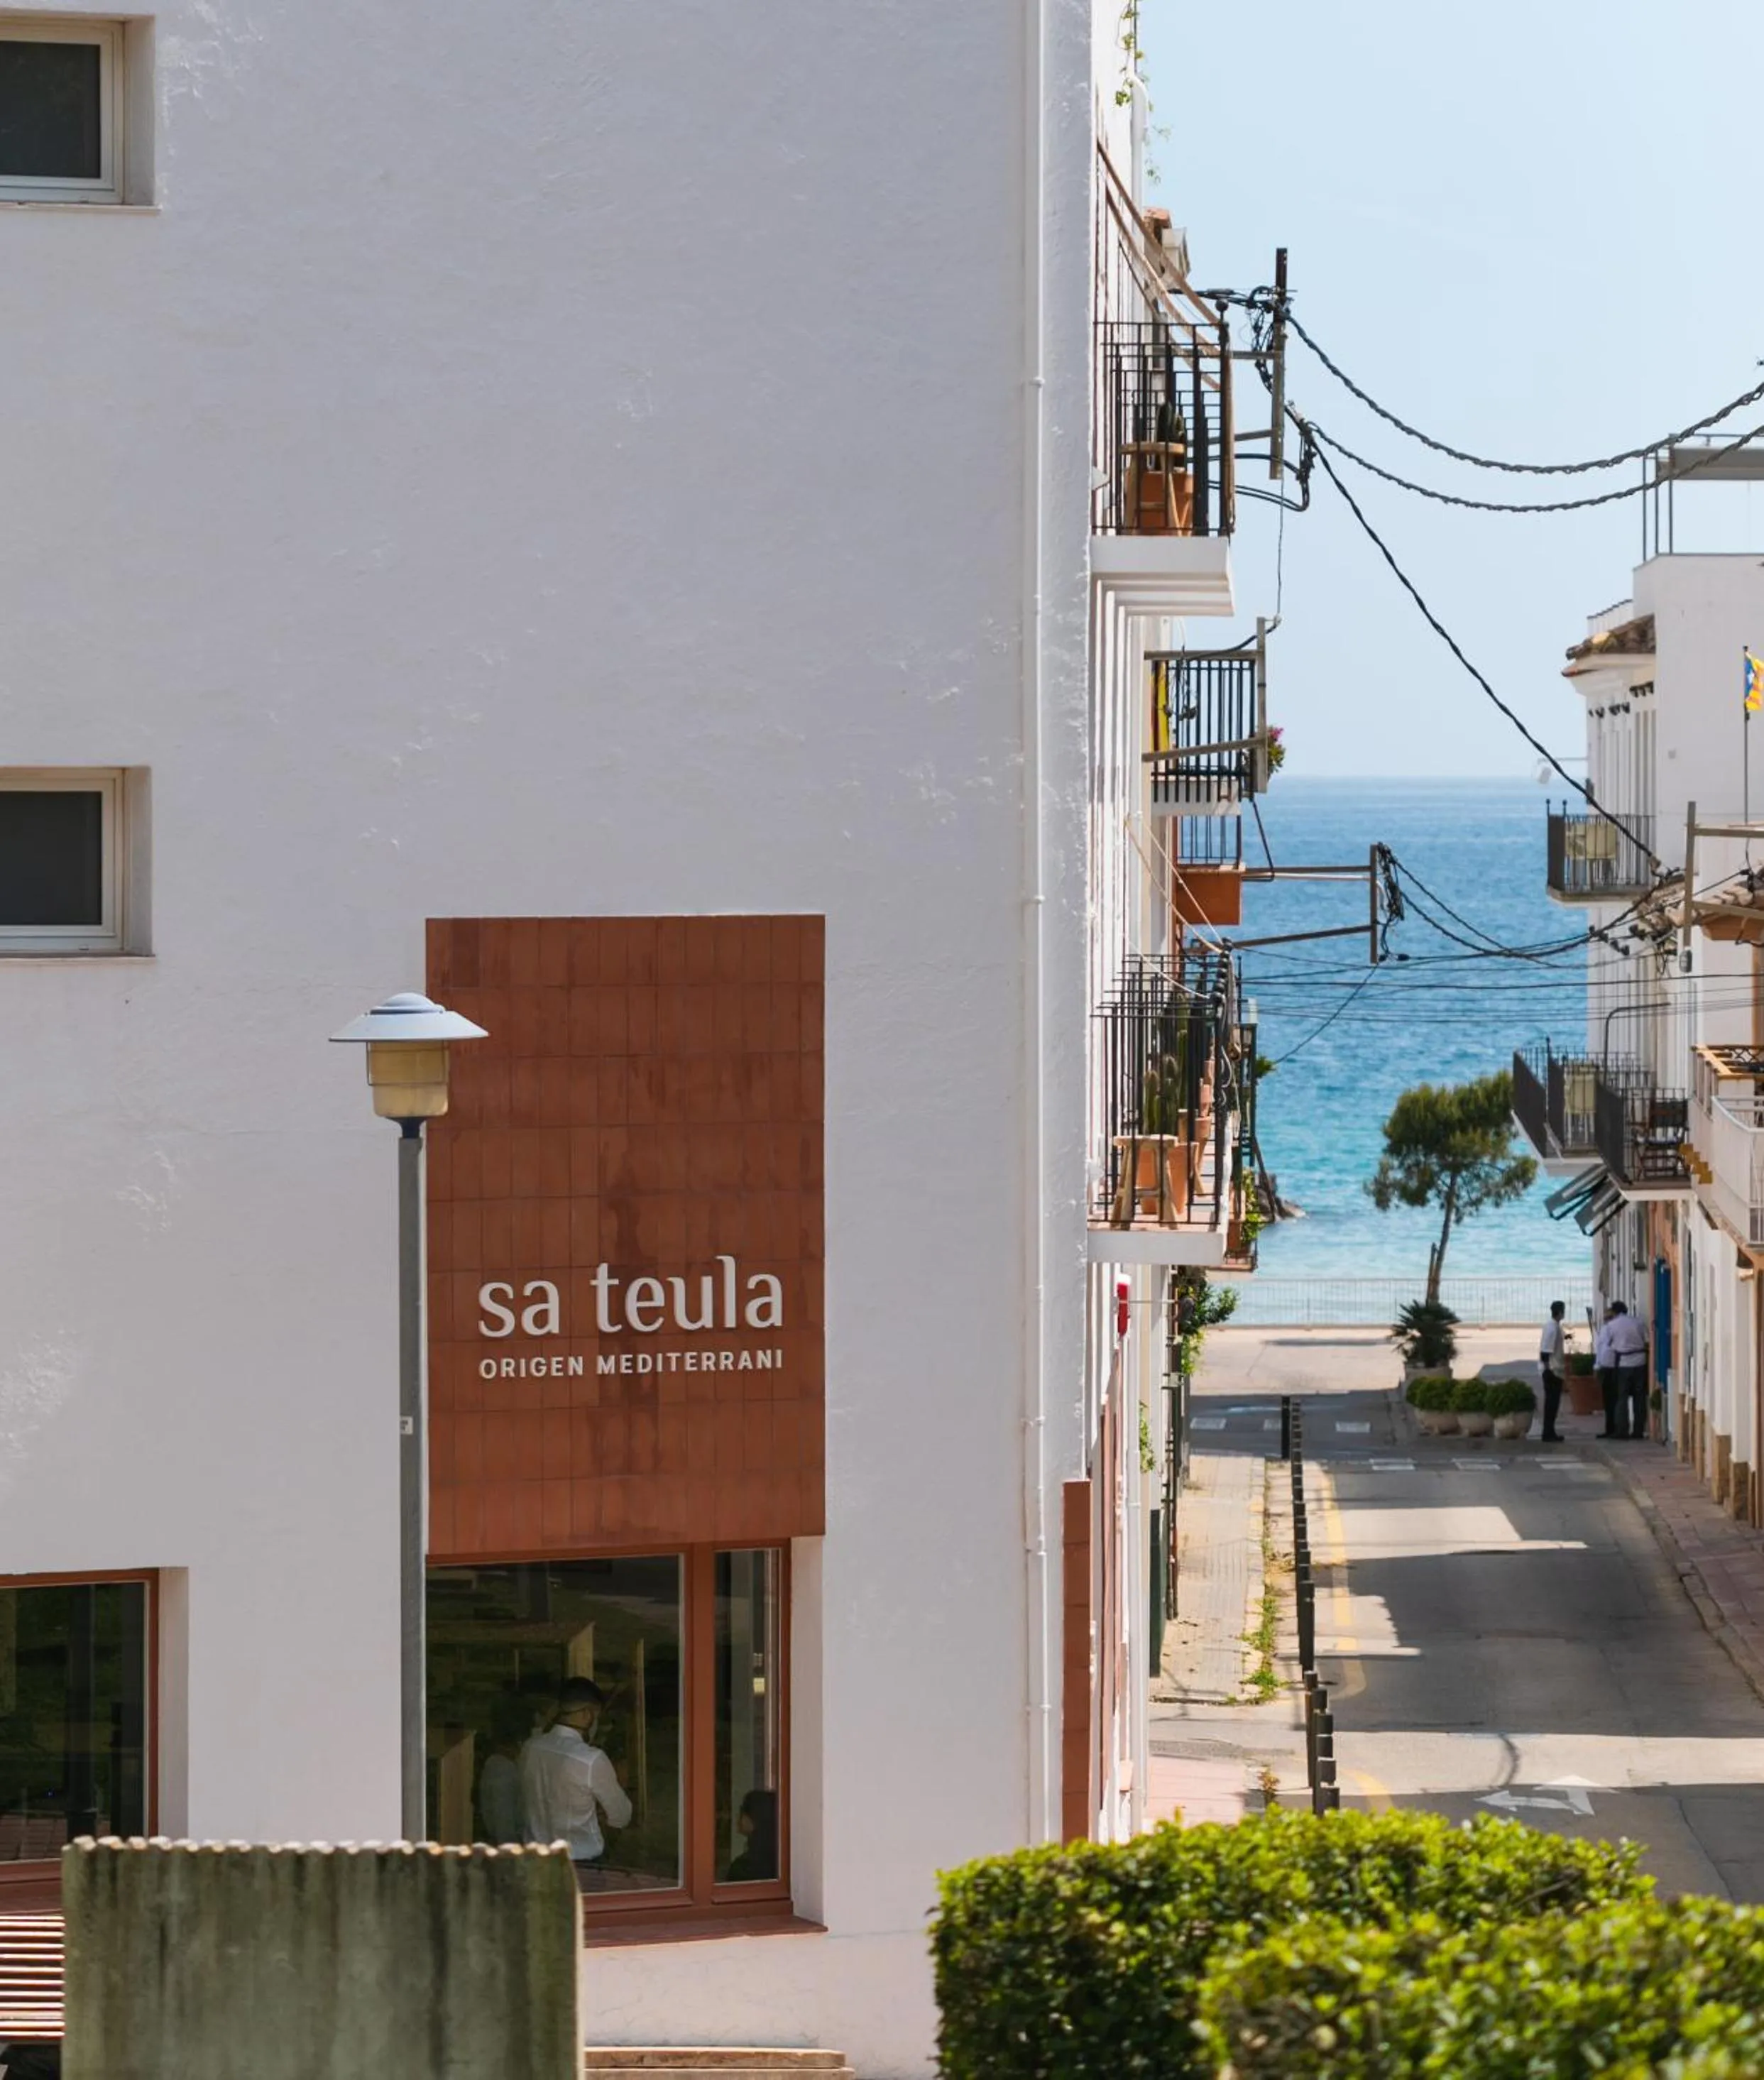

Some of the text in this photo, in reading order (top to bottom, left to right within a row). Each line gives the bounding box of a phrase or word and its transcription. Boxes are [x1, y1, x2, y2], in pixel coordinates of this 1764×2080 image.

[478, 1255, 783, 1337] sa teula
[479, 1349, 783, 1379] ORIGEN MEDITERRANI
